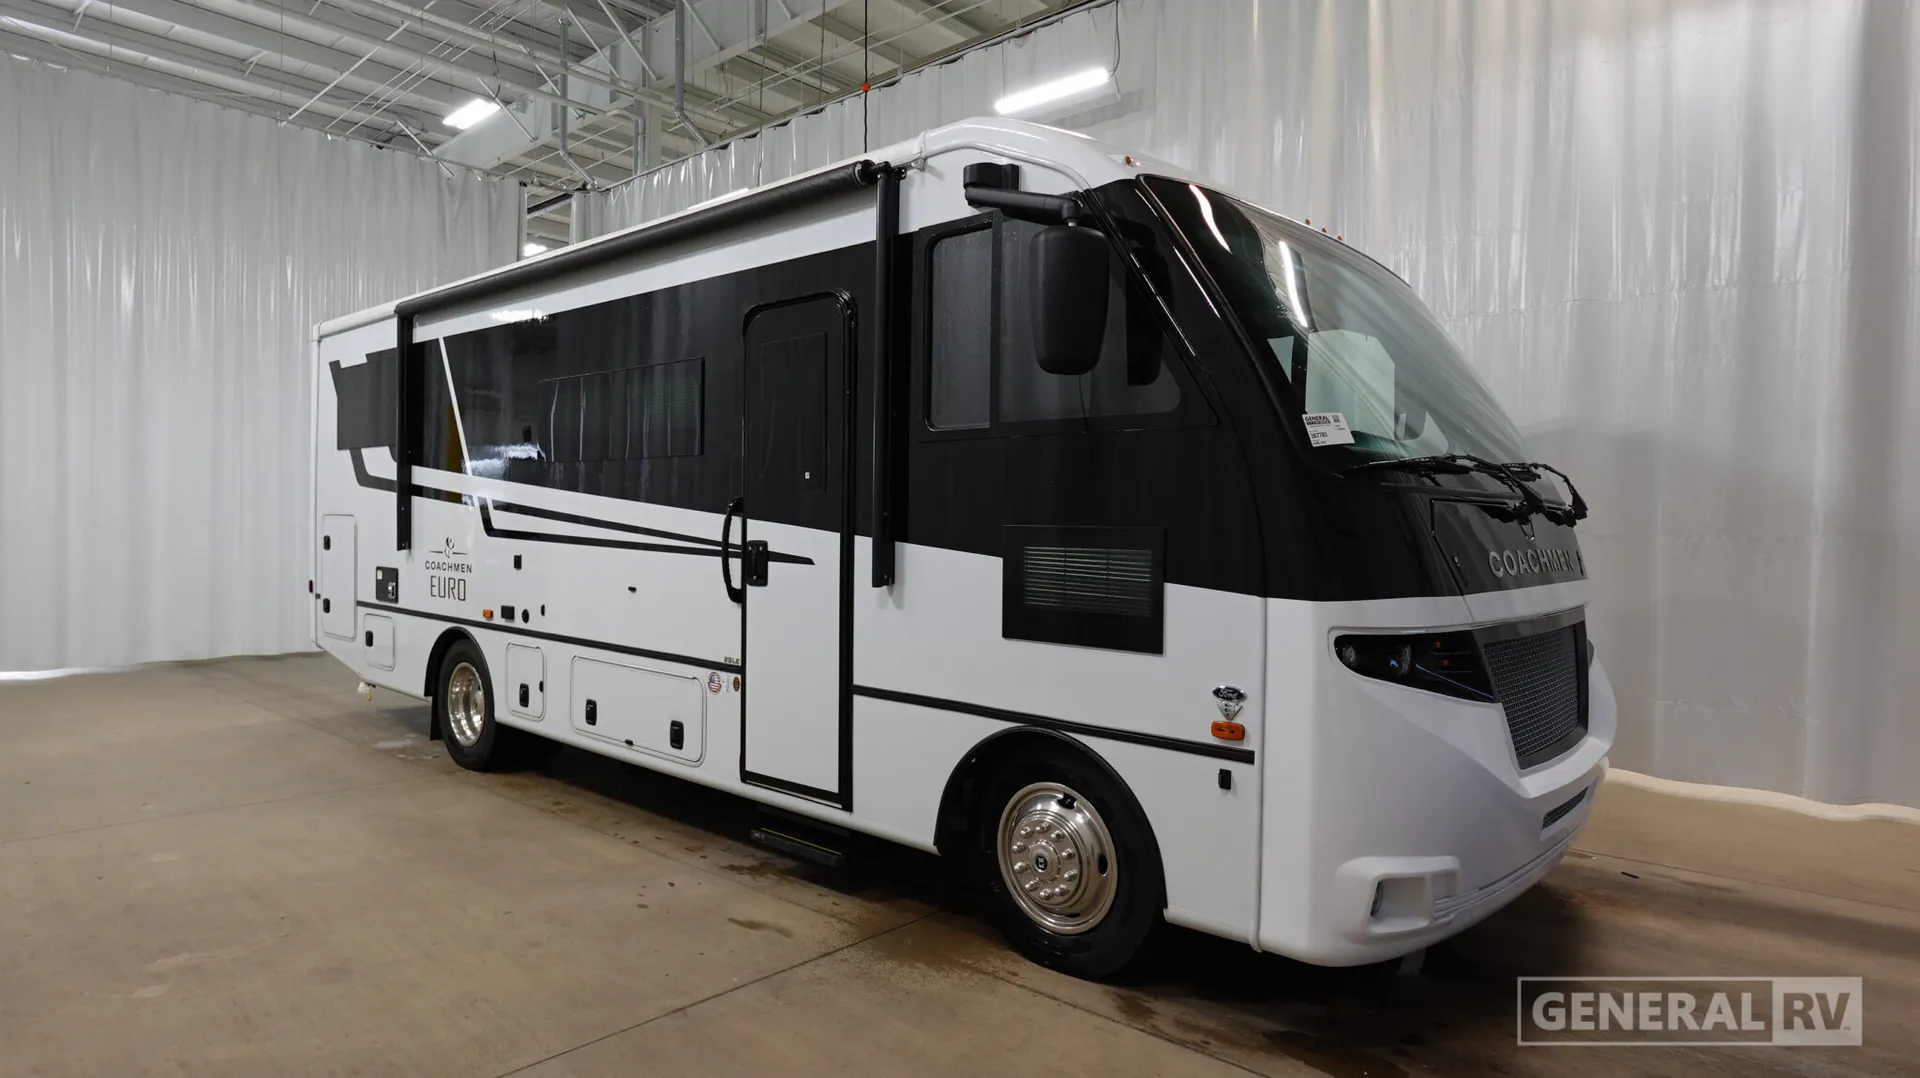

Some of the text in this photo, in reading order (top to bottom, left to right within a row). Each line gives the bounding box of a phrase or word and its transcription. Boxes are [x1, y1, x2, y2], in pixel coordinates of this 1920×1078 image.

[425, 560, 472, 573] COACHMEN
[1489, 549, 1574, 578] COACHMEN
[431, 575, 466, 601] EURO
[1218, 689, 1238, 699] Ford
